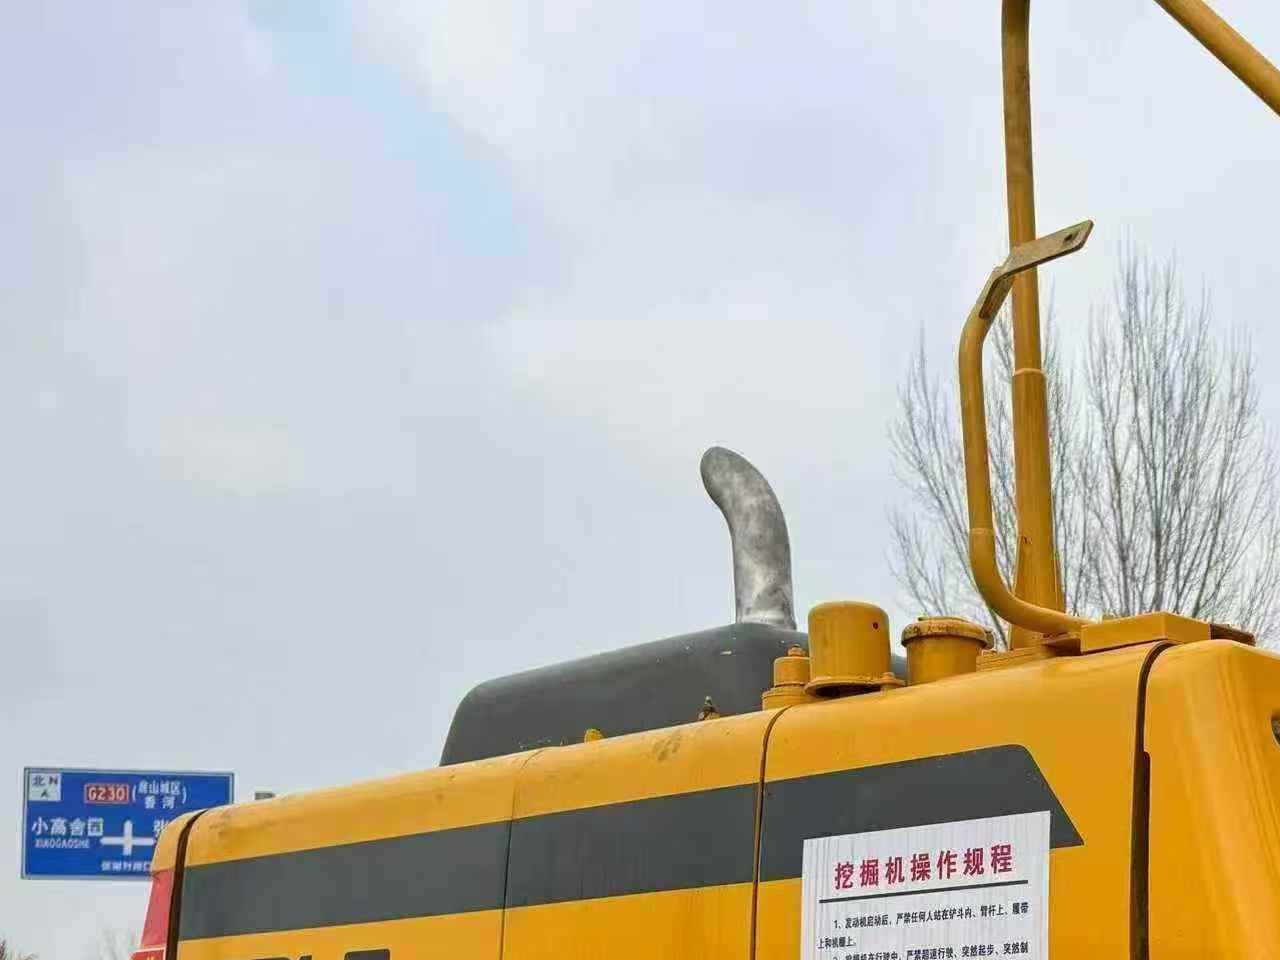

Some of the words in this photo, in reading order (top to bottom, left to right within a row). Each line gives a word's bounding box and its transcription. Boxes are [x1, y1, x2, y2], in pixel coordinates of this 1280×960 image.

[87, 786, 125, 801] G230
[834, 844, 1013, 890] 挖掘机操作规程
